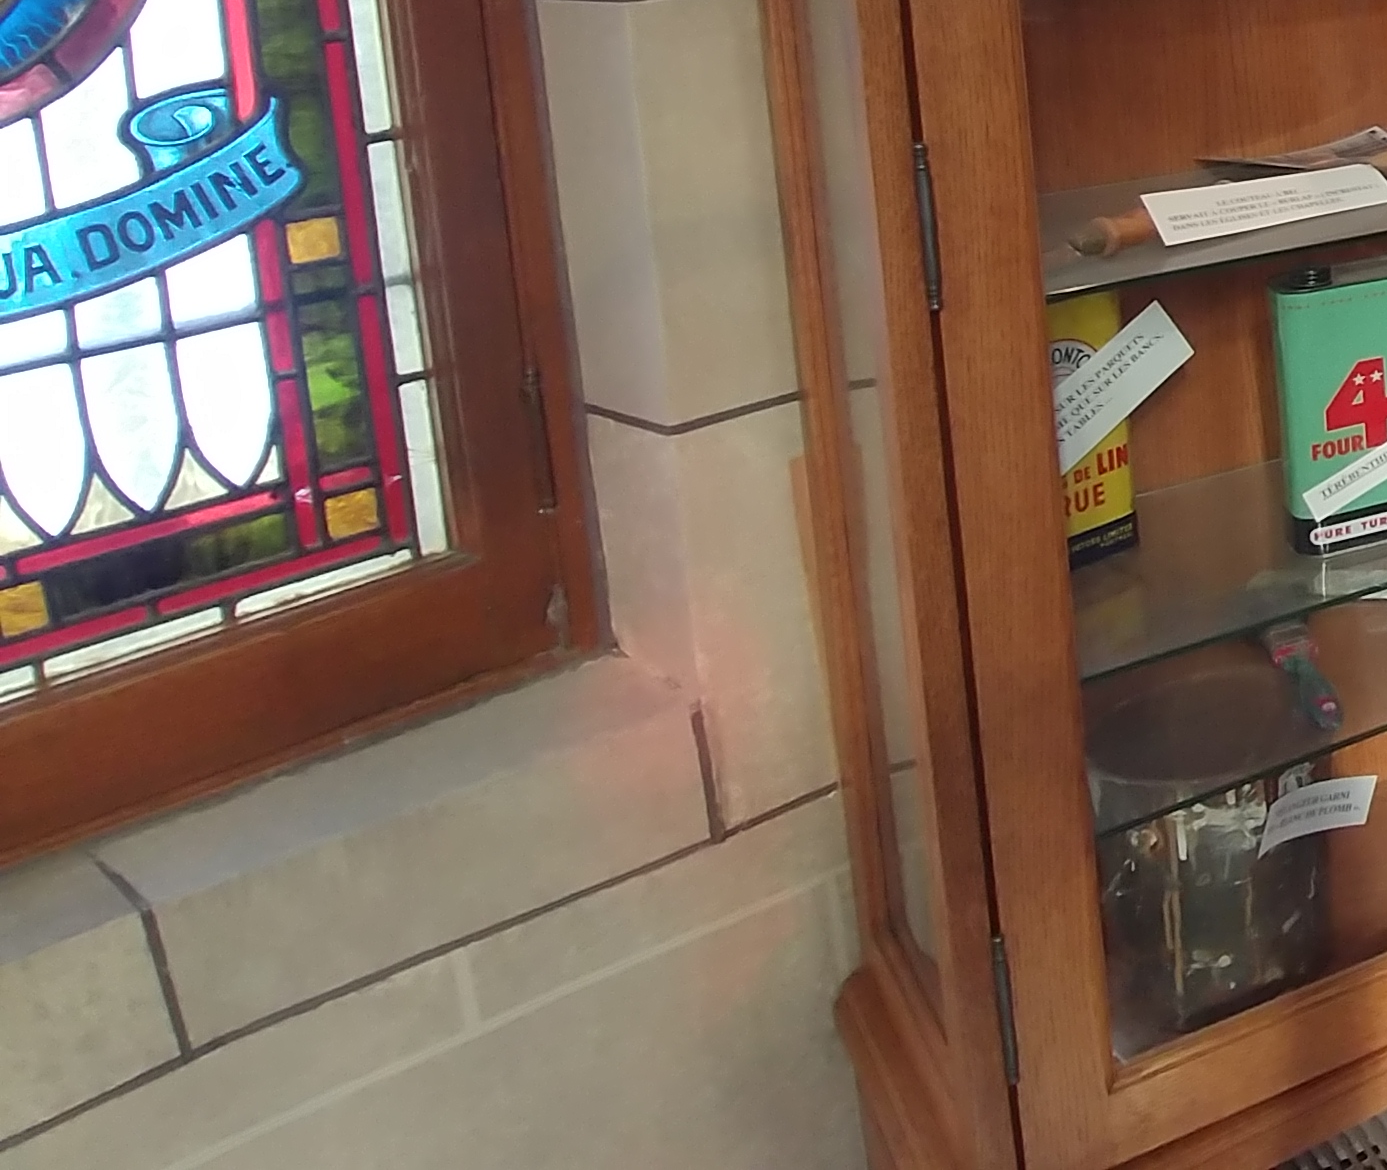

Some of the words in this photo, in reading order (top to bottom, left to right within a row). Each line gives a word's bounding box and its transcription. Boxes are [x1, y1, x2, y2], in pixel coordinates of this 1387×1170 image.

[75, 142, 289, 273] DOMINE
[1095, 334, 1144, 379] PARQUETS
[1093, 379, 1113, 396] SUR
[1112, 361, 1131, 380] LES
[1074, 466, 1091, 484] DE
[1096, 444, 1128, 476] LIN
[1312, 435, 1364, 462] FOUR
[1314, 525, 1352, 542] PURE
